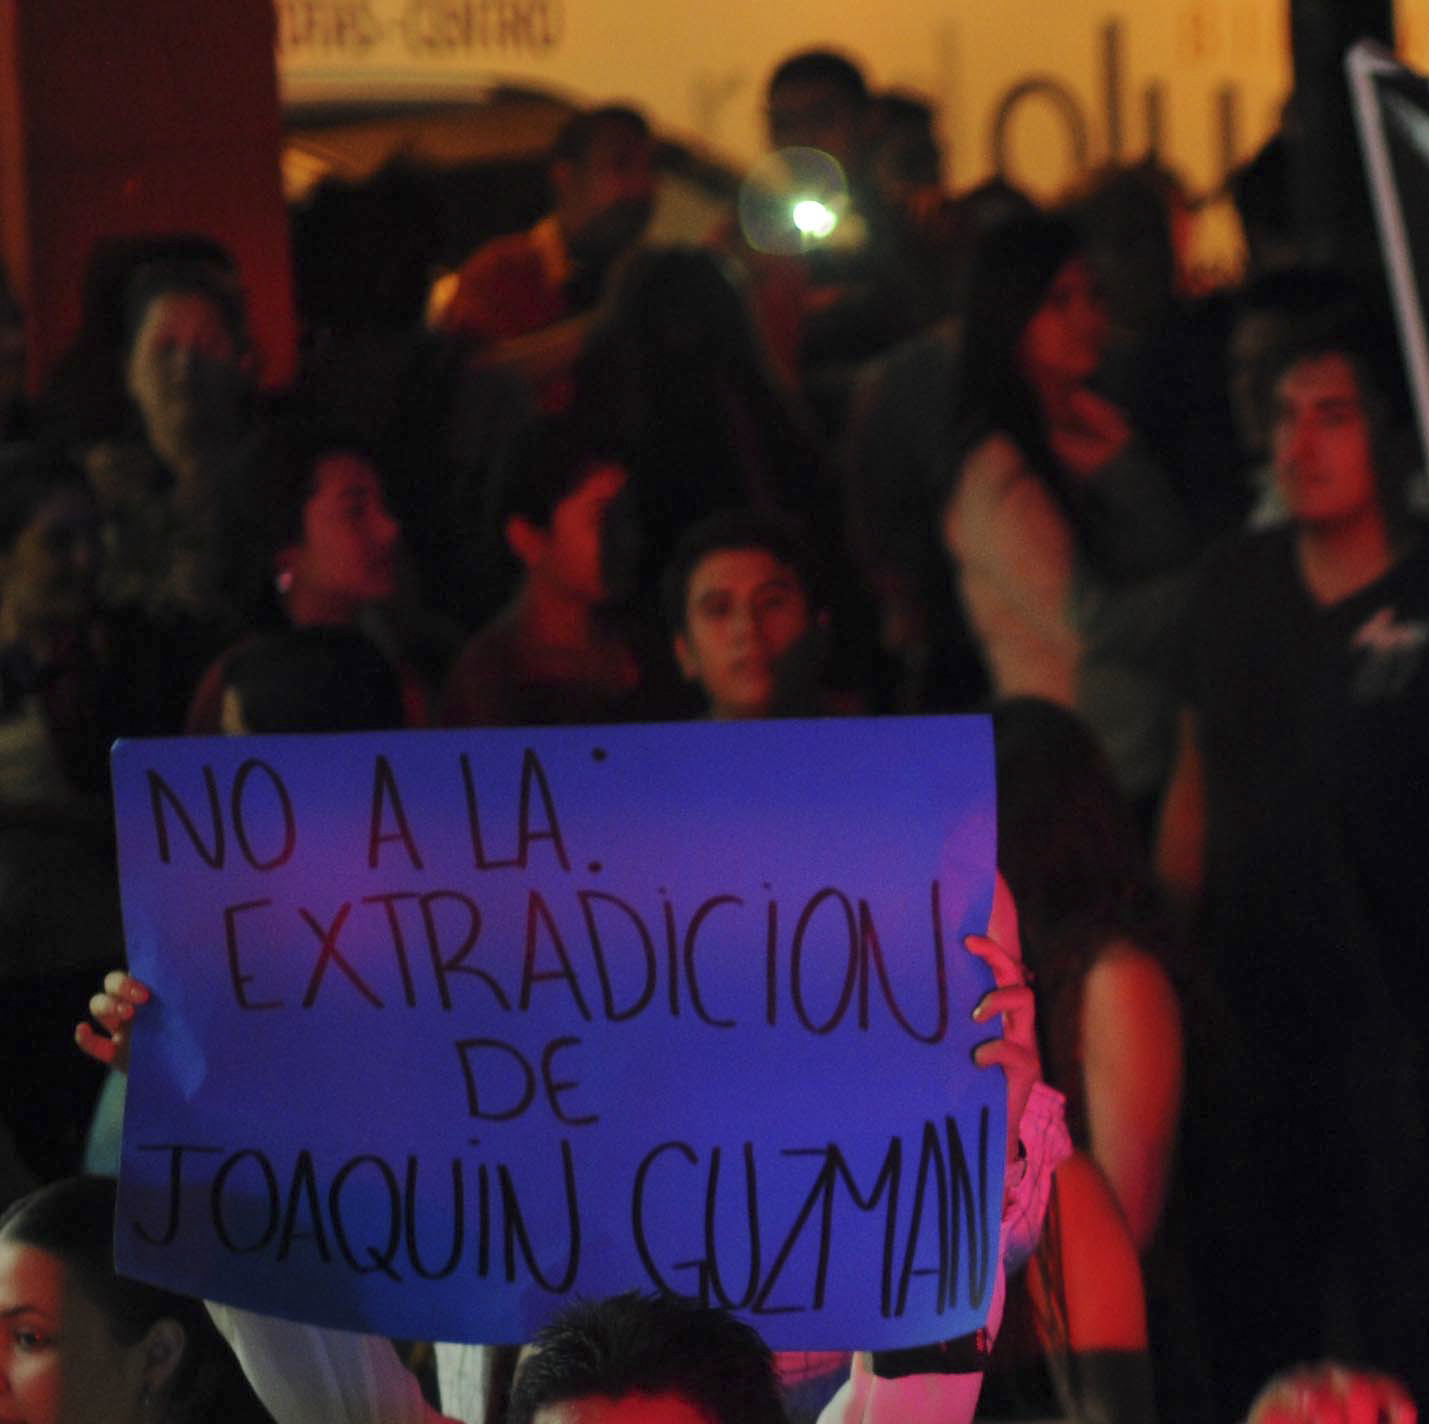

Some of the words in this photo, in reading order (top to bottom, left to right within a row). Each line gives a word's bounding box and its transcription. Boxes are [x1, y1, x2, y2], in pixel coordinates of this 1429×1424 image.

[146, 757, 297, 871] NO
[366, 753, 425, 871] A
[455, 1036, 599, 1127] DE
[630, 1105, 991, 1319] GUZMAN
